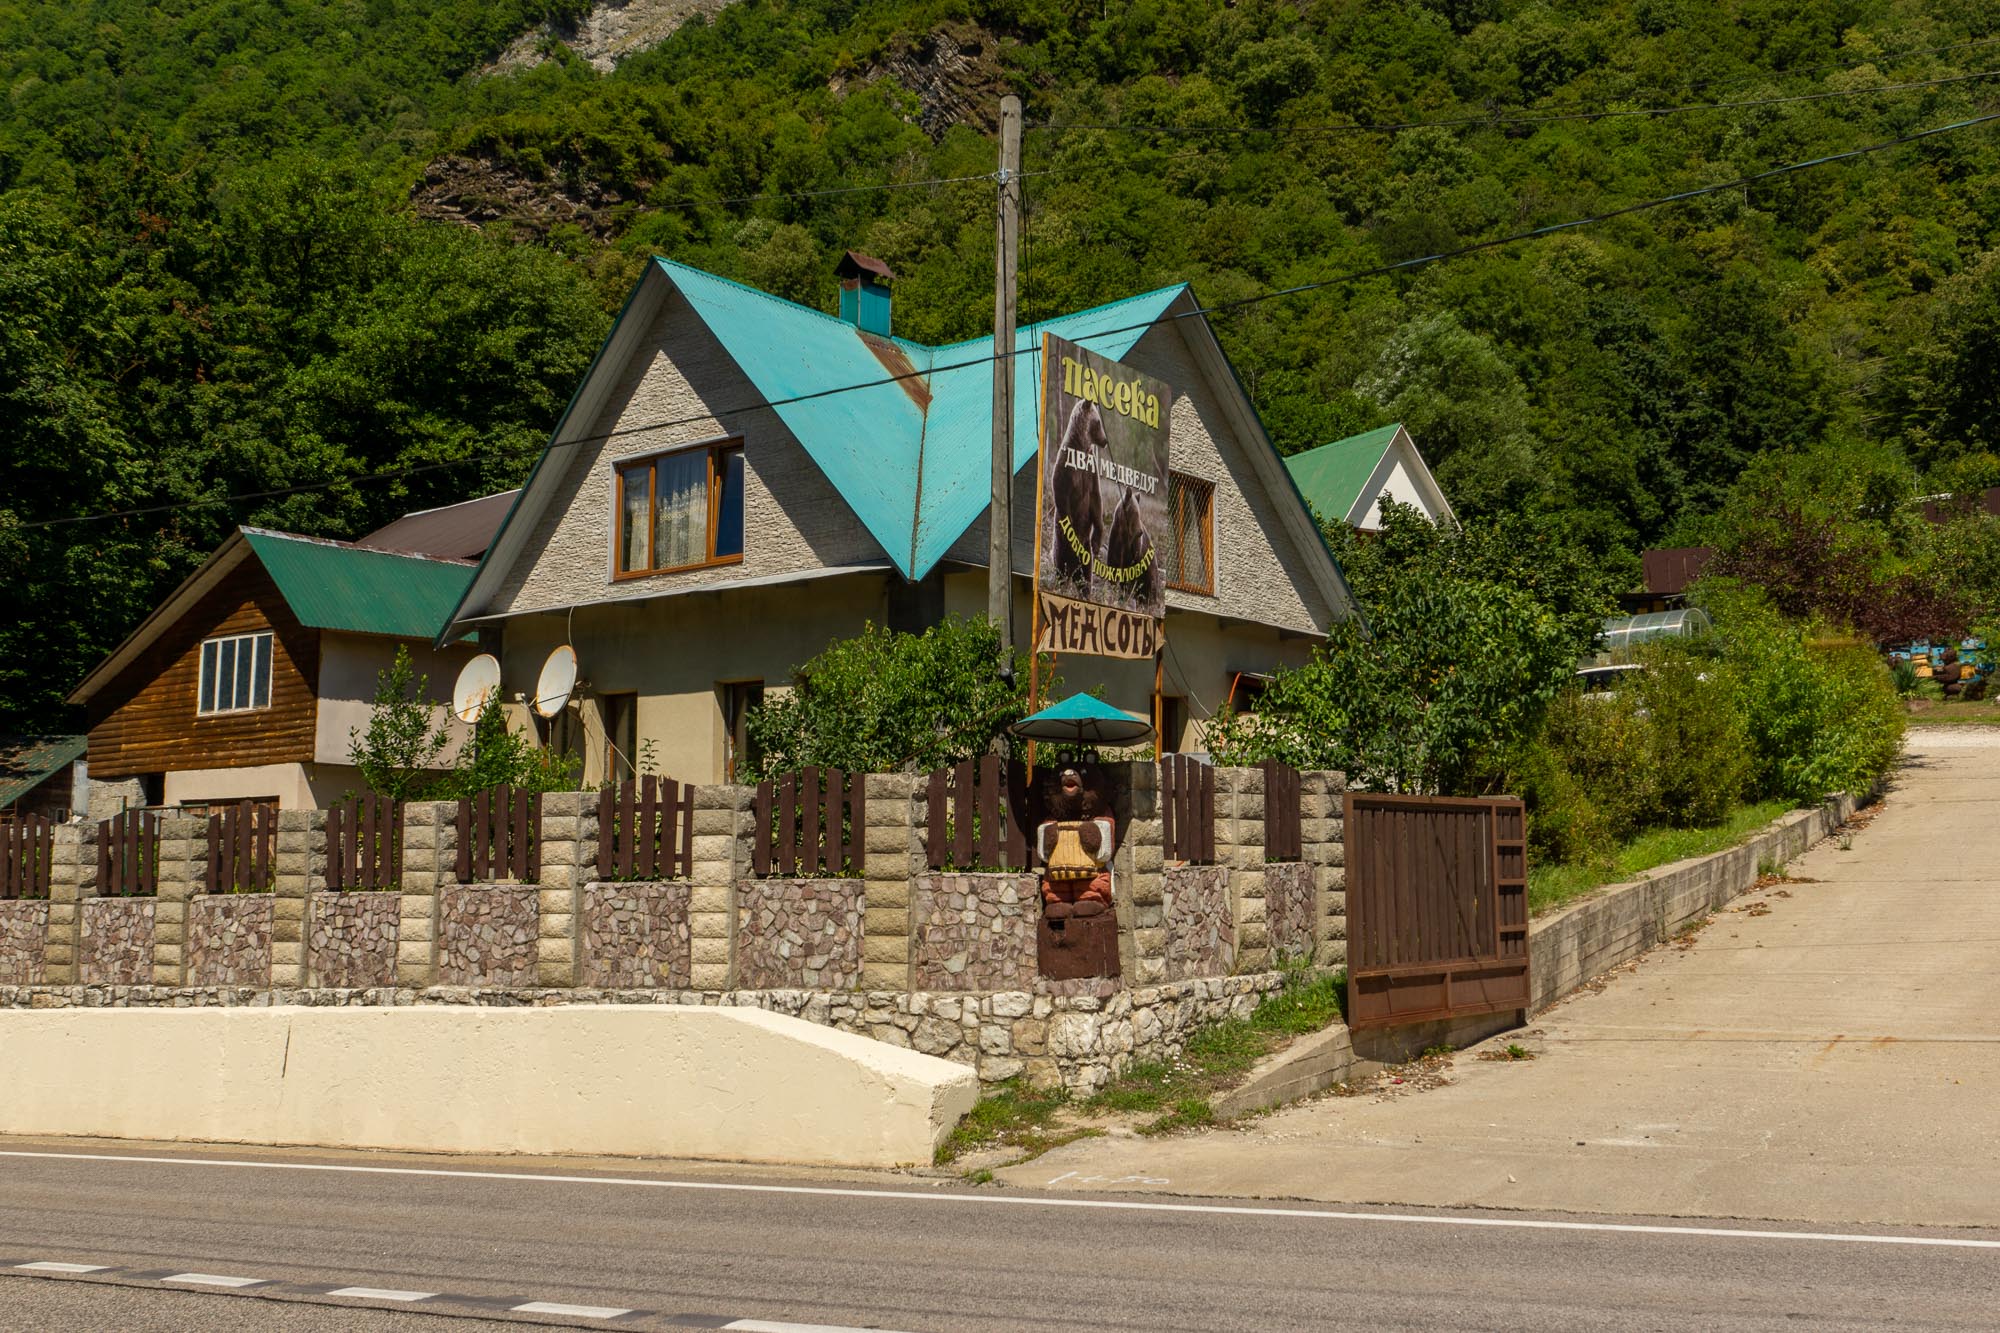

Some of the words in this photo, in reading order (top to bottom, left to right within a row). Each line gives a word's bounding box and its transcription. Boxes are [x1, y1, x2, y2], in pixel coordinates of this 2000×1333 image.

[1058, 515, 1091, 566] ДОБРО
[1049, 601, 1099, 653] МЁД
[1104, 611, 1156, 656] СОТЫ
